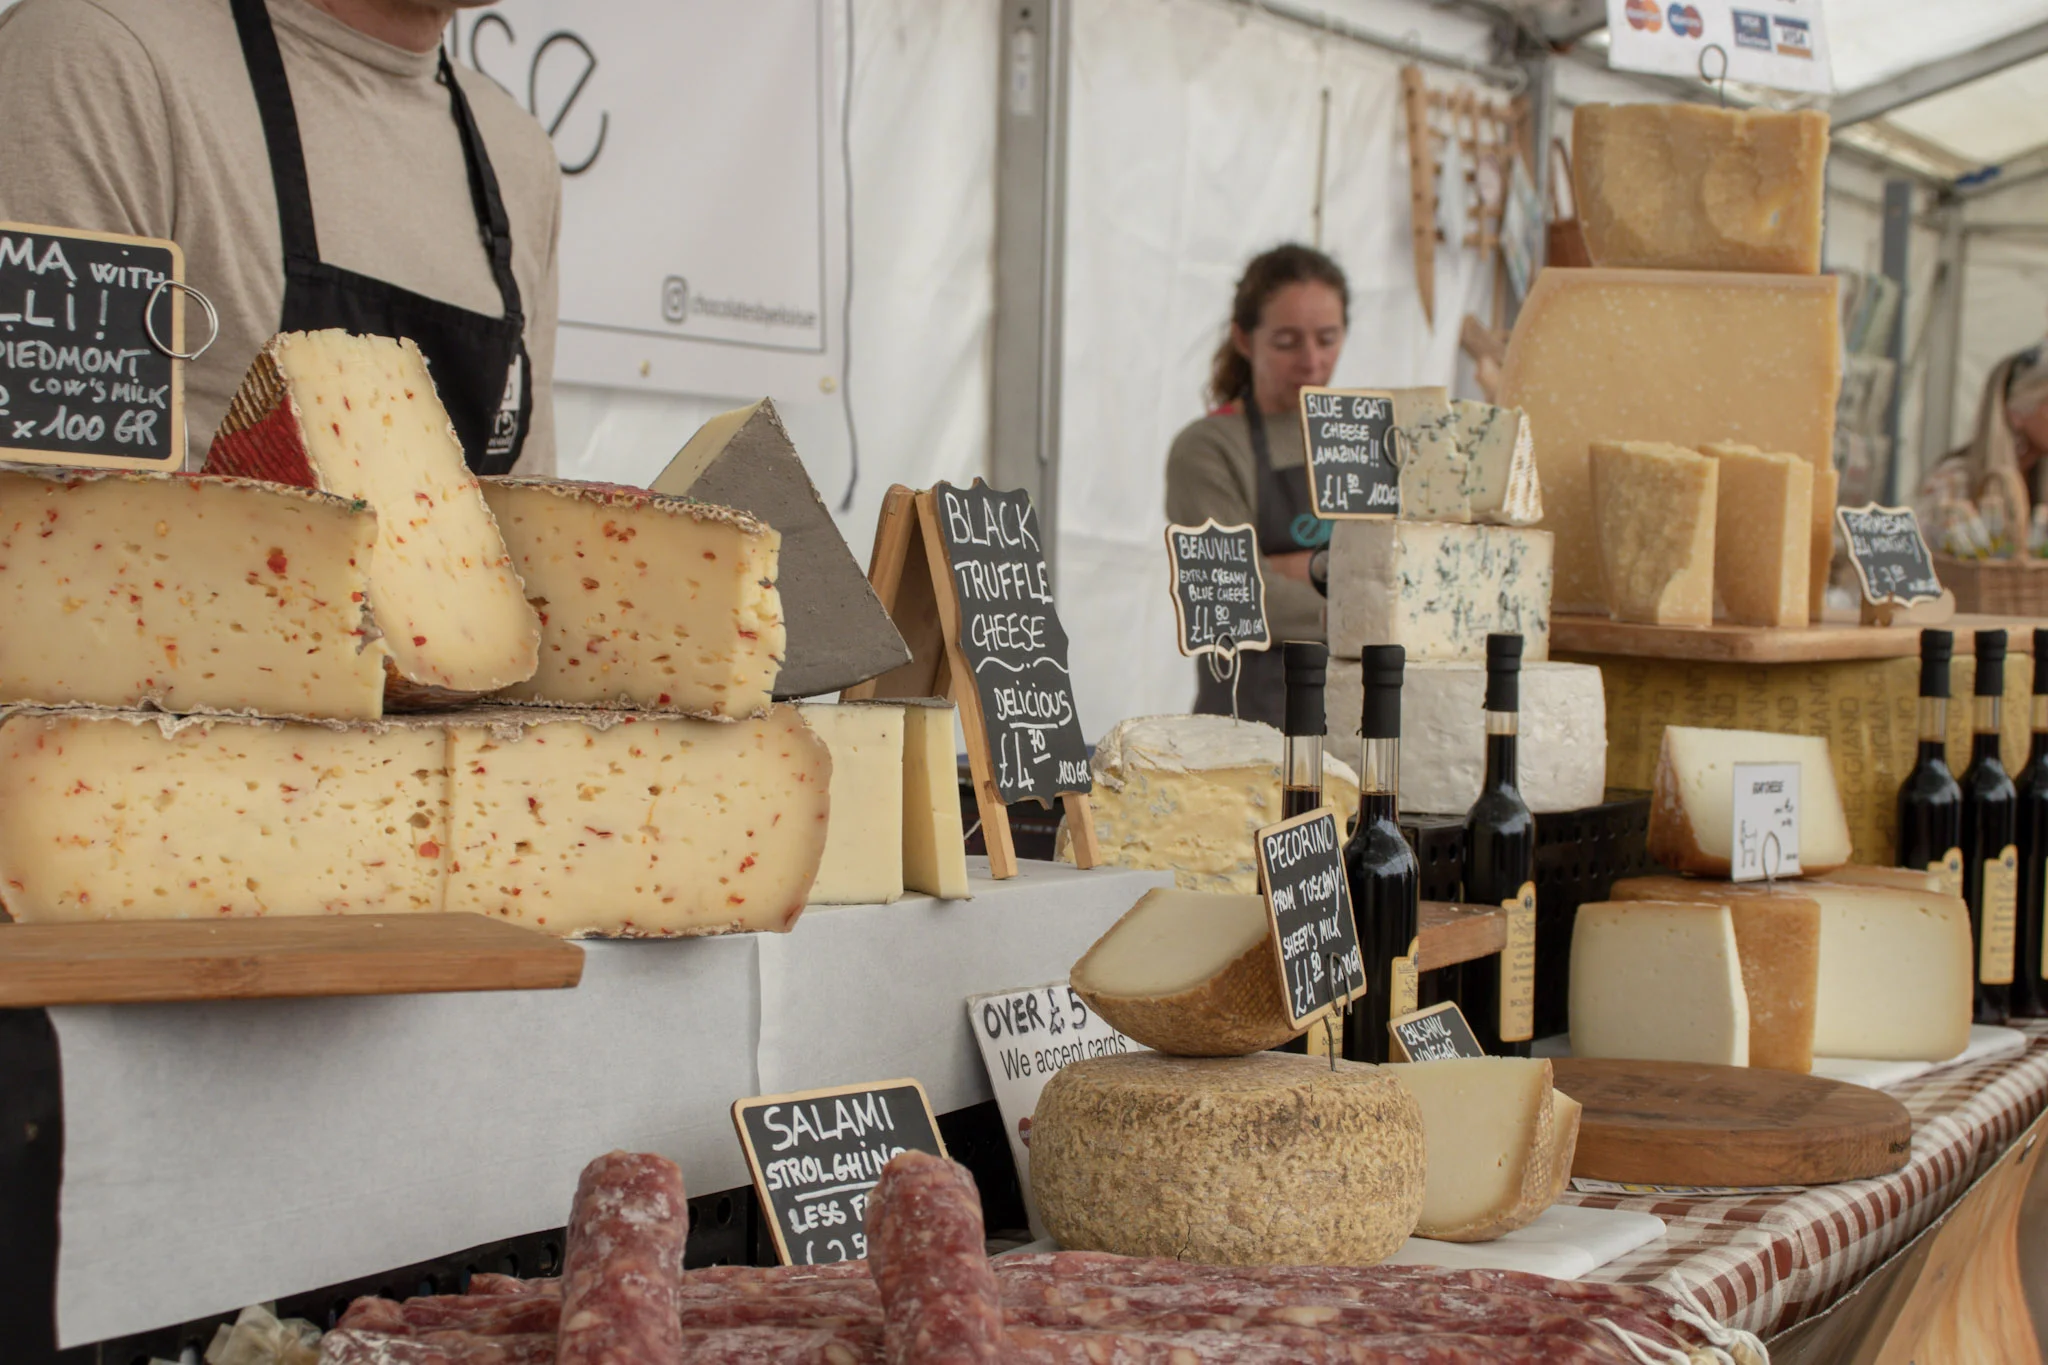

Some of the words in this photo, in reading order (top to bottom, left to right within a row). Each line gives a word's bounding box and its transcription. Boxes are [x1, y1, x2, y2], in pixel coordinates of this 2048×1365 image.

[90, 251, 168, 292] WITH
[30, 377, 107, 403] COW'S
[111, 378, 169, 410] MILK
[1306, 394, 1343, 419] BLUE
[1352, 397, 1392, 421] GOAT
[40, 405, 105, 442] 100
[114, 409, 158, 446] GR
[1321, 422, 1370, 441] CHEESE
[946, 492, 1040, 553] BLACK
[1178, 535, 1248, 564] BEAUVALE
[954, 560, 1053, 604] TRUFFLE
[1179, 568, 1208, 584] EXTRA
[1211, 567, 1248, 591] CREAMY
[1188, 583, 1214, 602] BLUE
[971, 613, 1046, 652] CHEESE
[993, 681, 1073, 727] DELICIOUS
[1266, 815, 1336, 874] PECORINO
[1273, 884, 1296, 916] FROM
[1282, 921, 1318, 961] SHEEP'S
[1319, 907, 1342, 945] MILK
[983, 992, 1046, 1040] OVER
[1000, 1047, 1031, 1081] We
[763, 1093, 895, 1151] SALAMI
[788, 1200, 847, 1235] LESS
